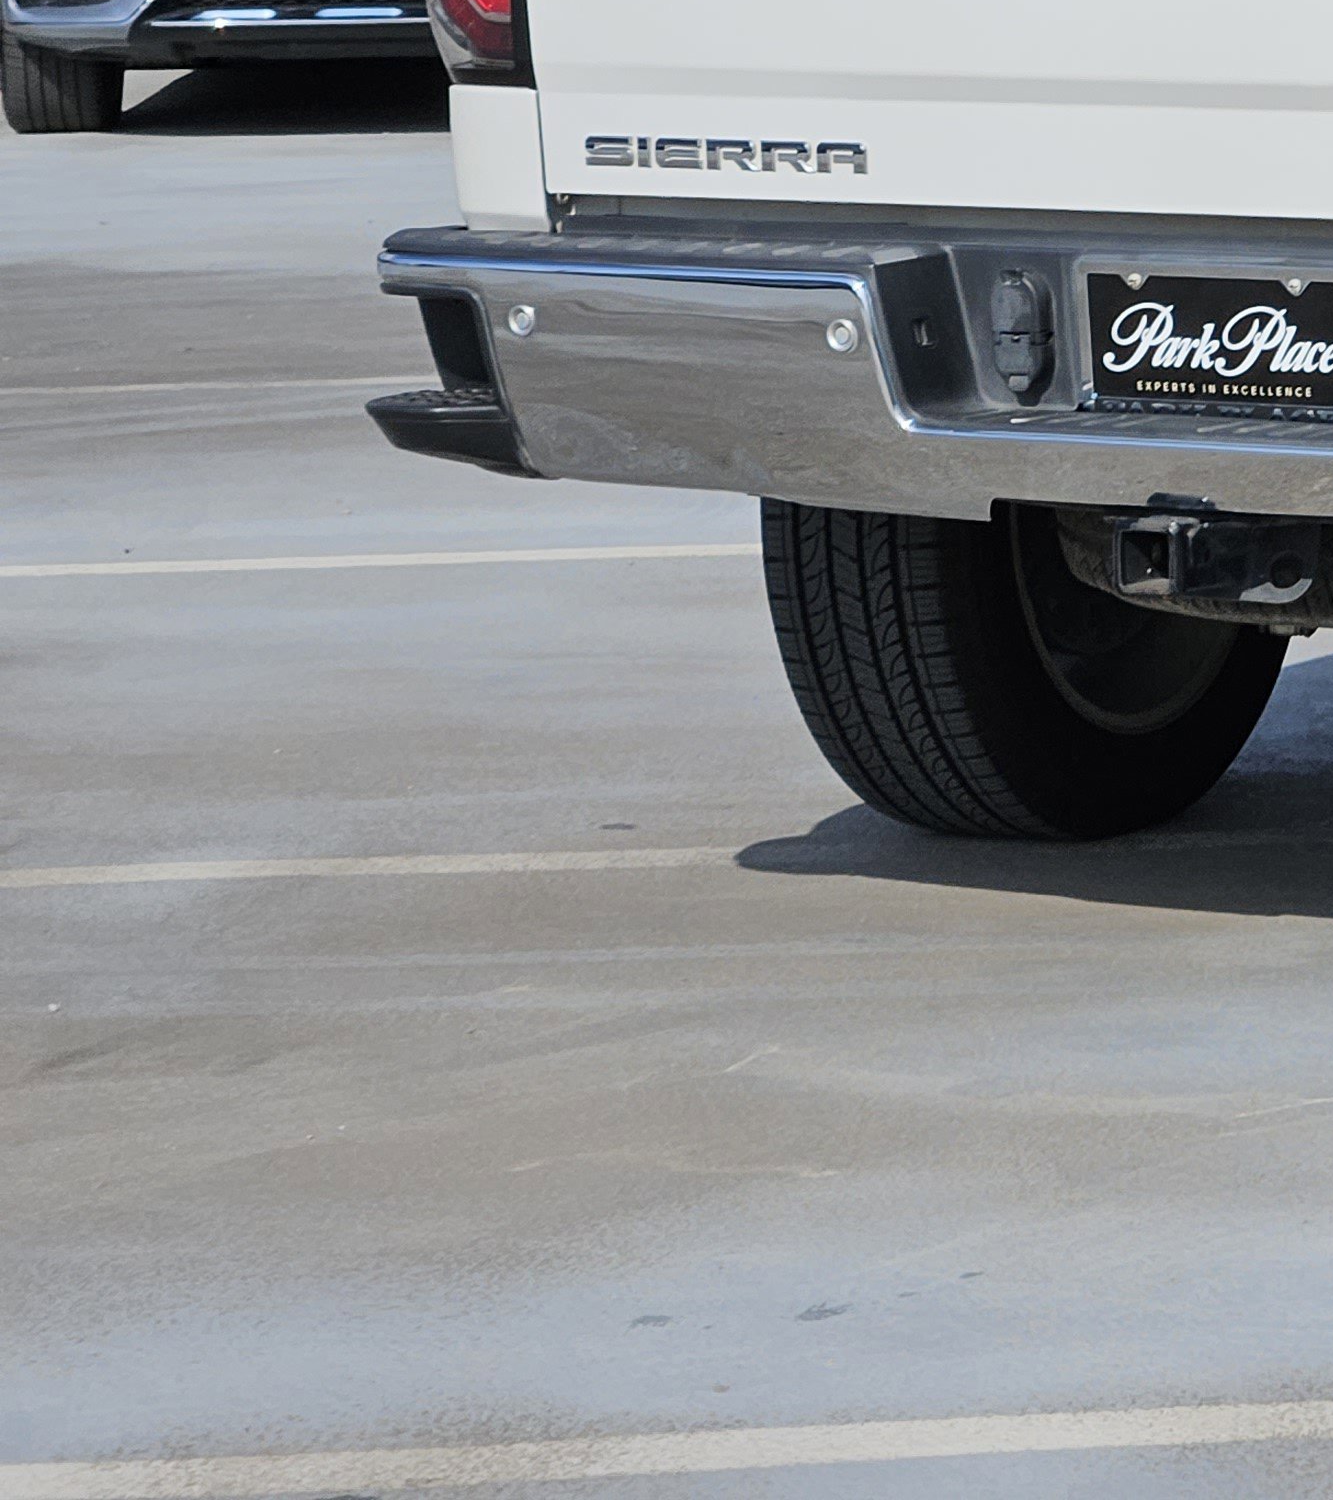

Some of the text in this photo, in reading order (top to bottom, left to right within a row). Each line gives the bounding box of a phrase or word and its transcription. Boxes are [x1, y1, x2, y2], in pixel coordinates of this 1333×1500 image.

[585, 135, 868, 174] SIERRA
[1102, 302, 1221, 373] Park
[1136, 379, 1313, 398] EXPERTS IN EXCELLENCE
